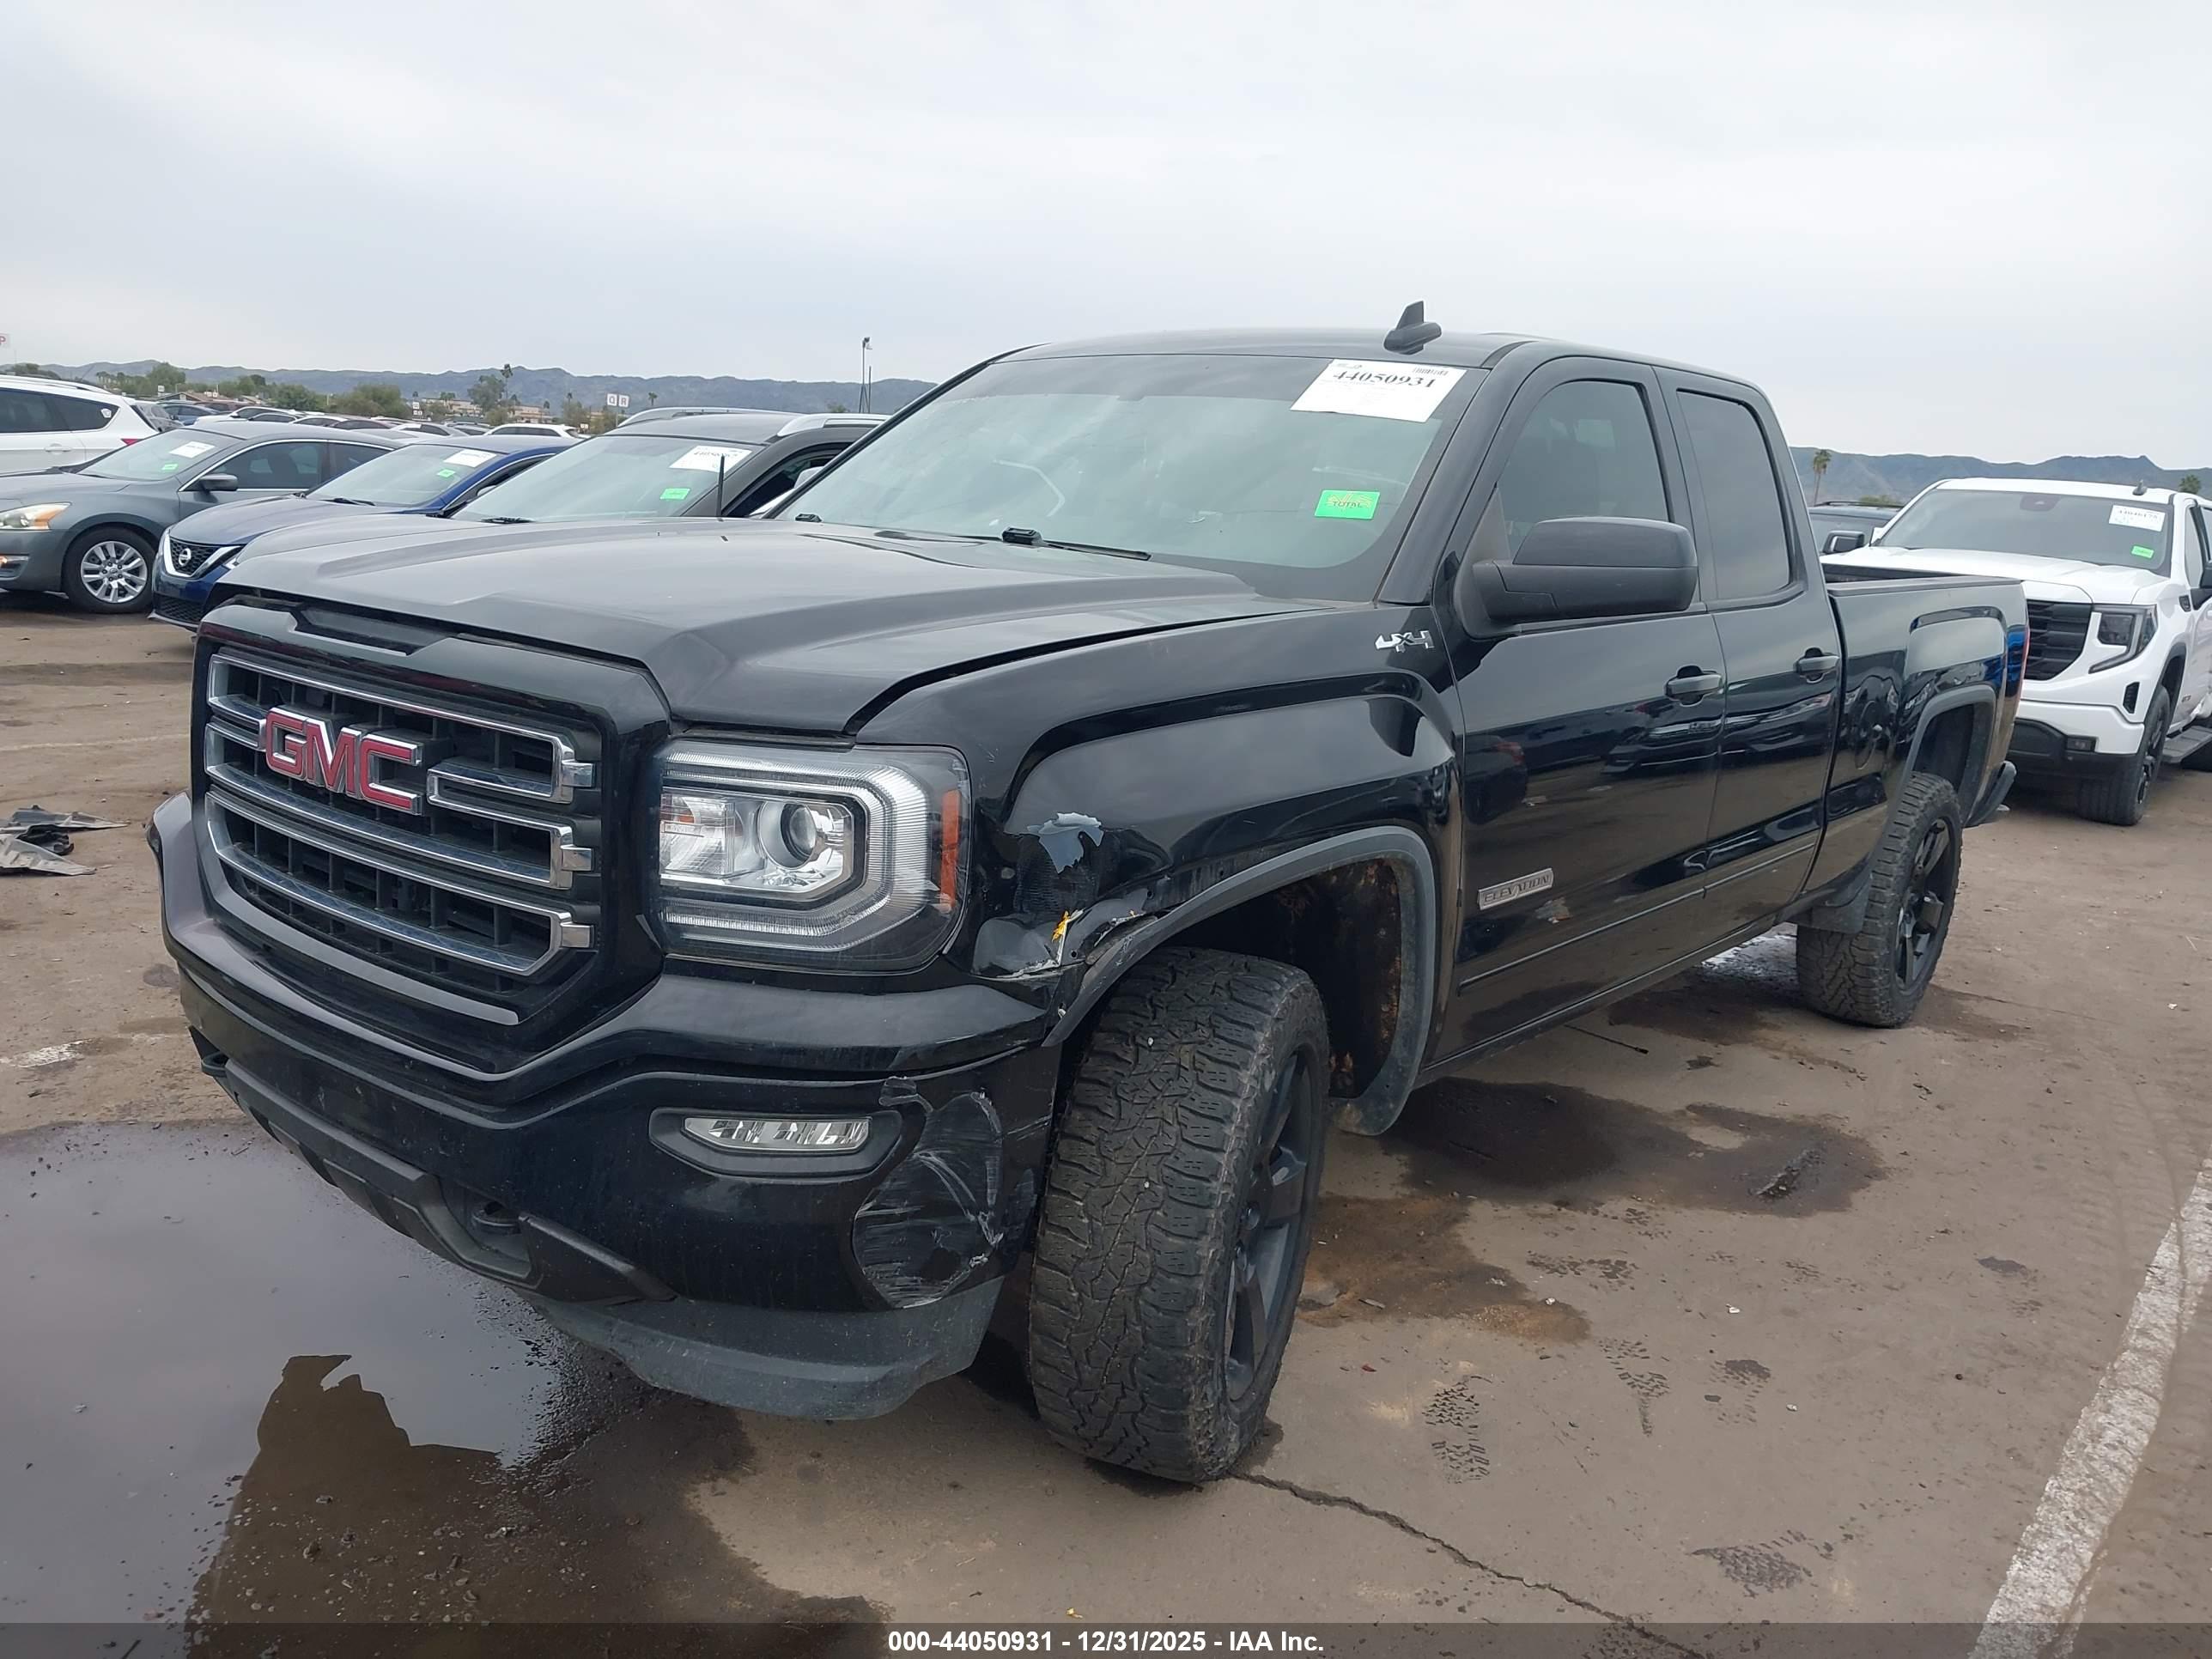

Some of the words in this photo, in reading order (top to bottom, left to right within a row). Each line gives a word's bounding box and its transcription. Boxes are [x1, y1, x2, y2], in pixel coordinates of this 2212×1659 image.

[1333, 370, 1437, 388] 44050931
[265, 707, 424, 817] GMC
[1483, 873, 1550, 906] ELEVATION
